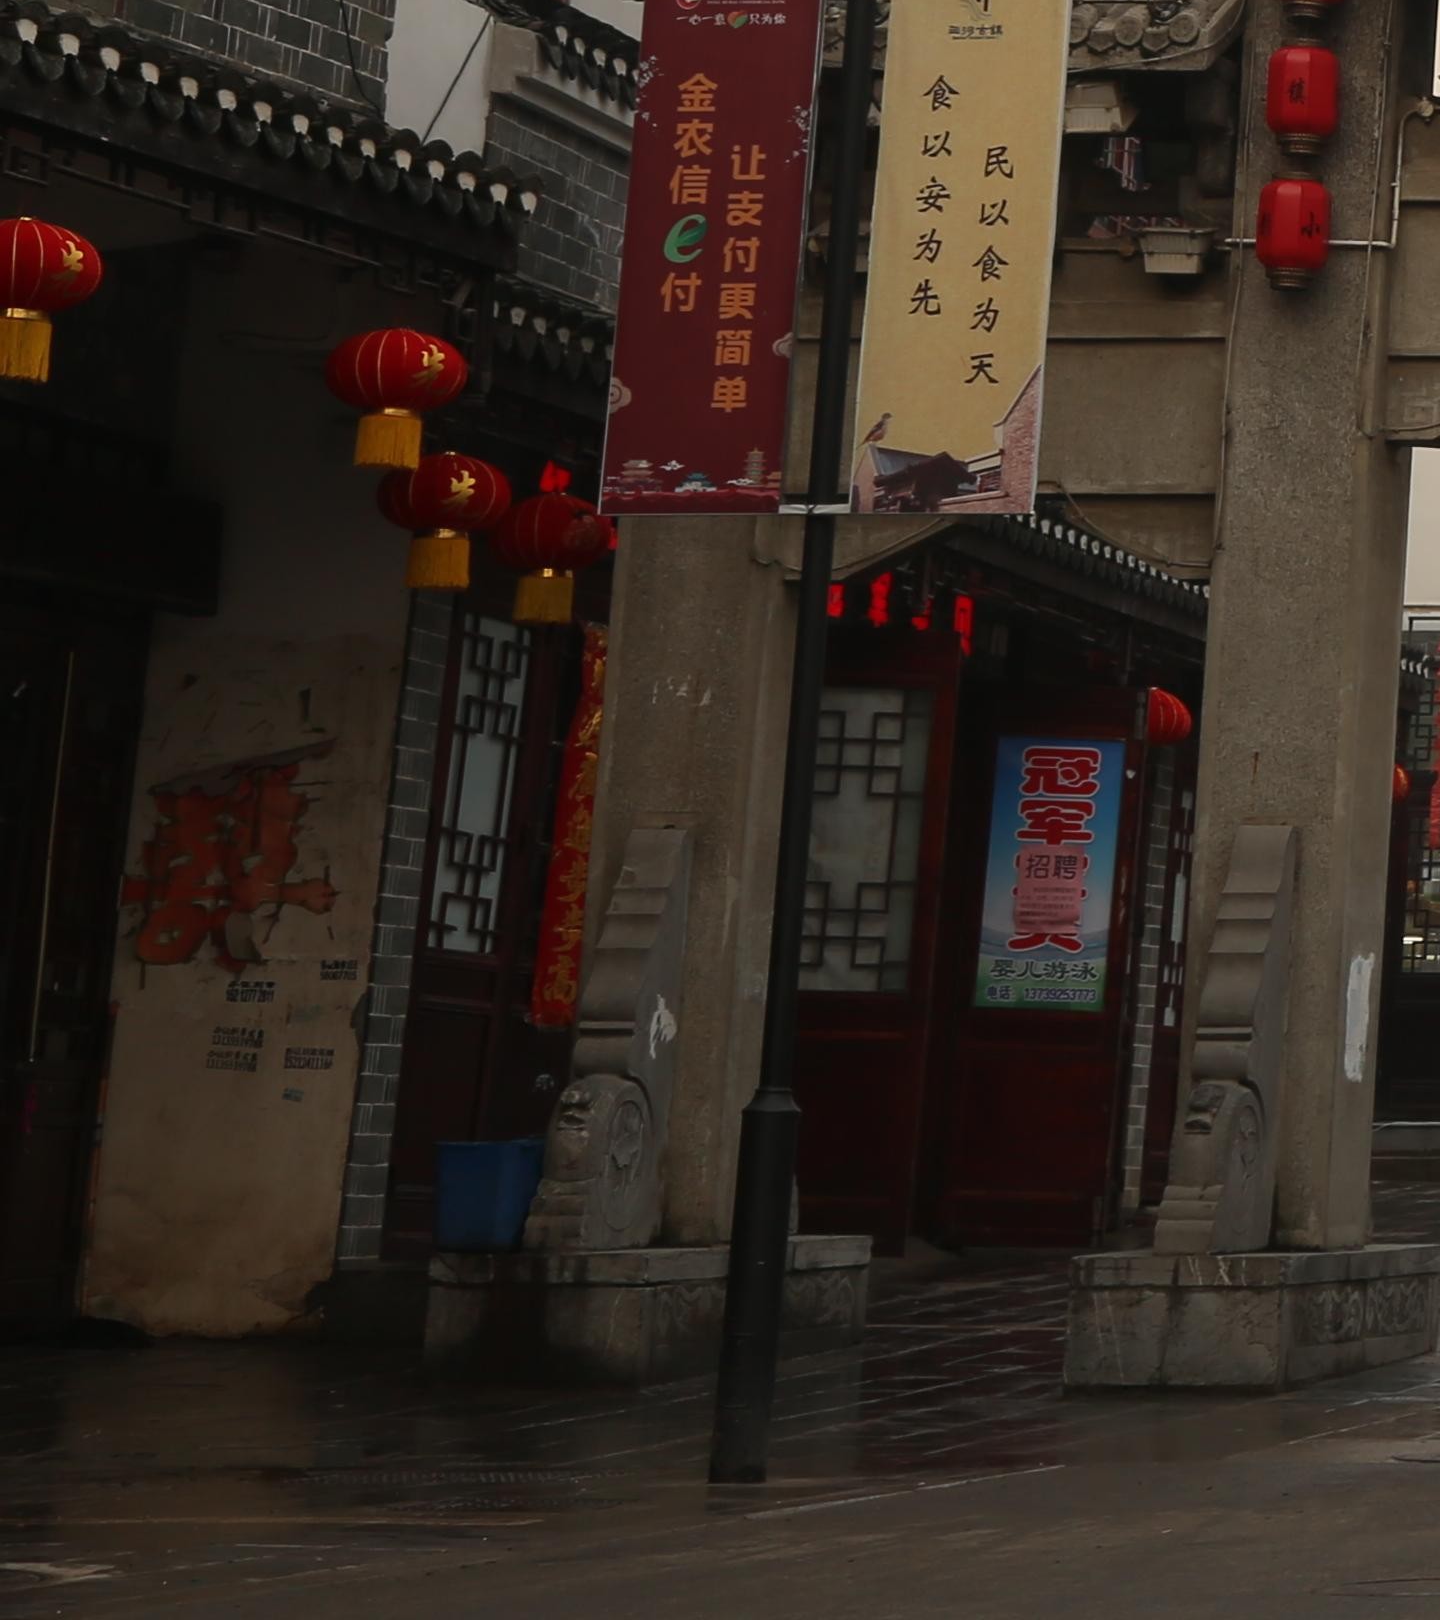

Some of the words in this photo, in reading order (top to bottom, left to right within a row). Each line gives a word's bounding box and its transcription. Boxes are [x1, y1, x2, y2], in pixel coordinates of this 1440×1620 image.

[660, 72, 718, 313] 金农信e付
[710, 144, 766, 413] 让支付更简单
[909, 74, 960, 317] 食以安为先
[963, 145, 1014, 385] 民以食为天
[990, 959, 1097, 980] 婴儿游泳
[1025, 854, 1079, 880] 招聘
